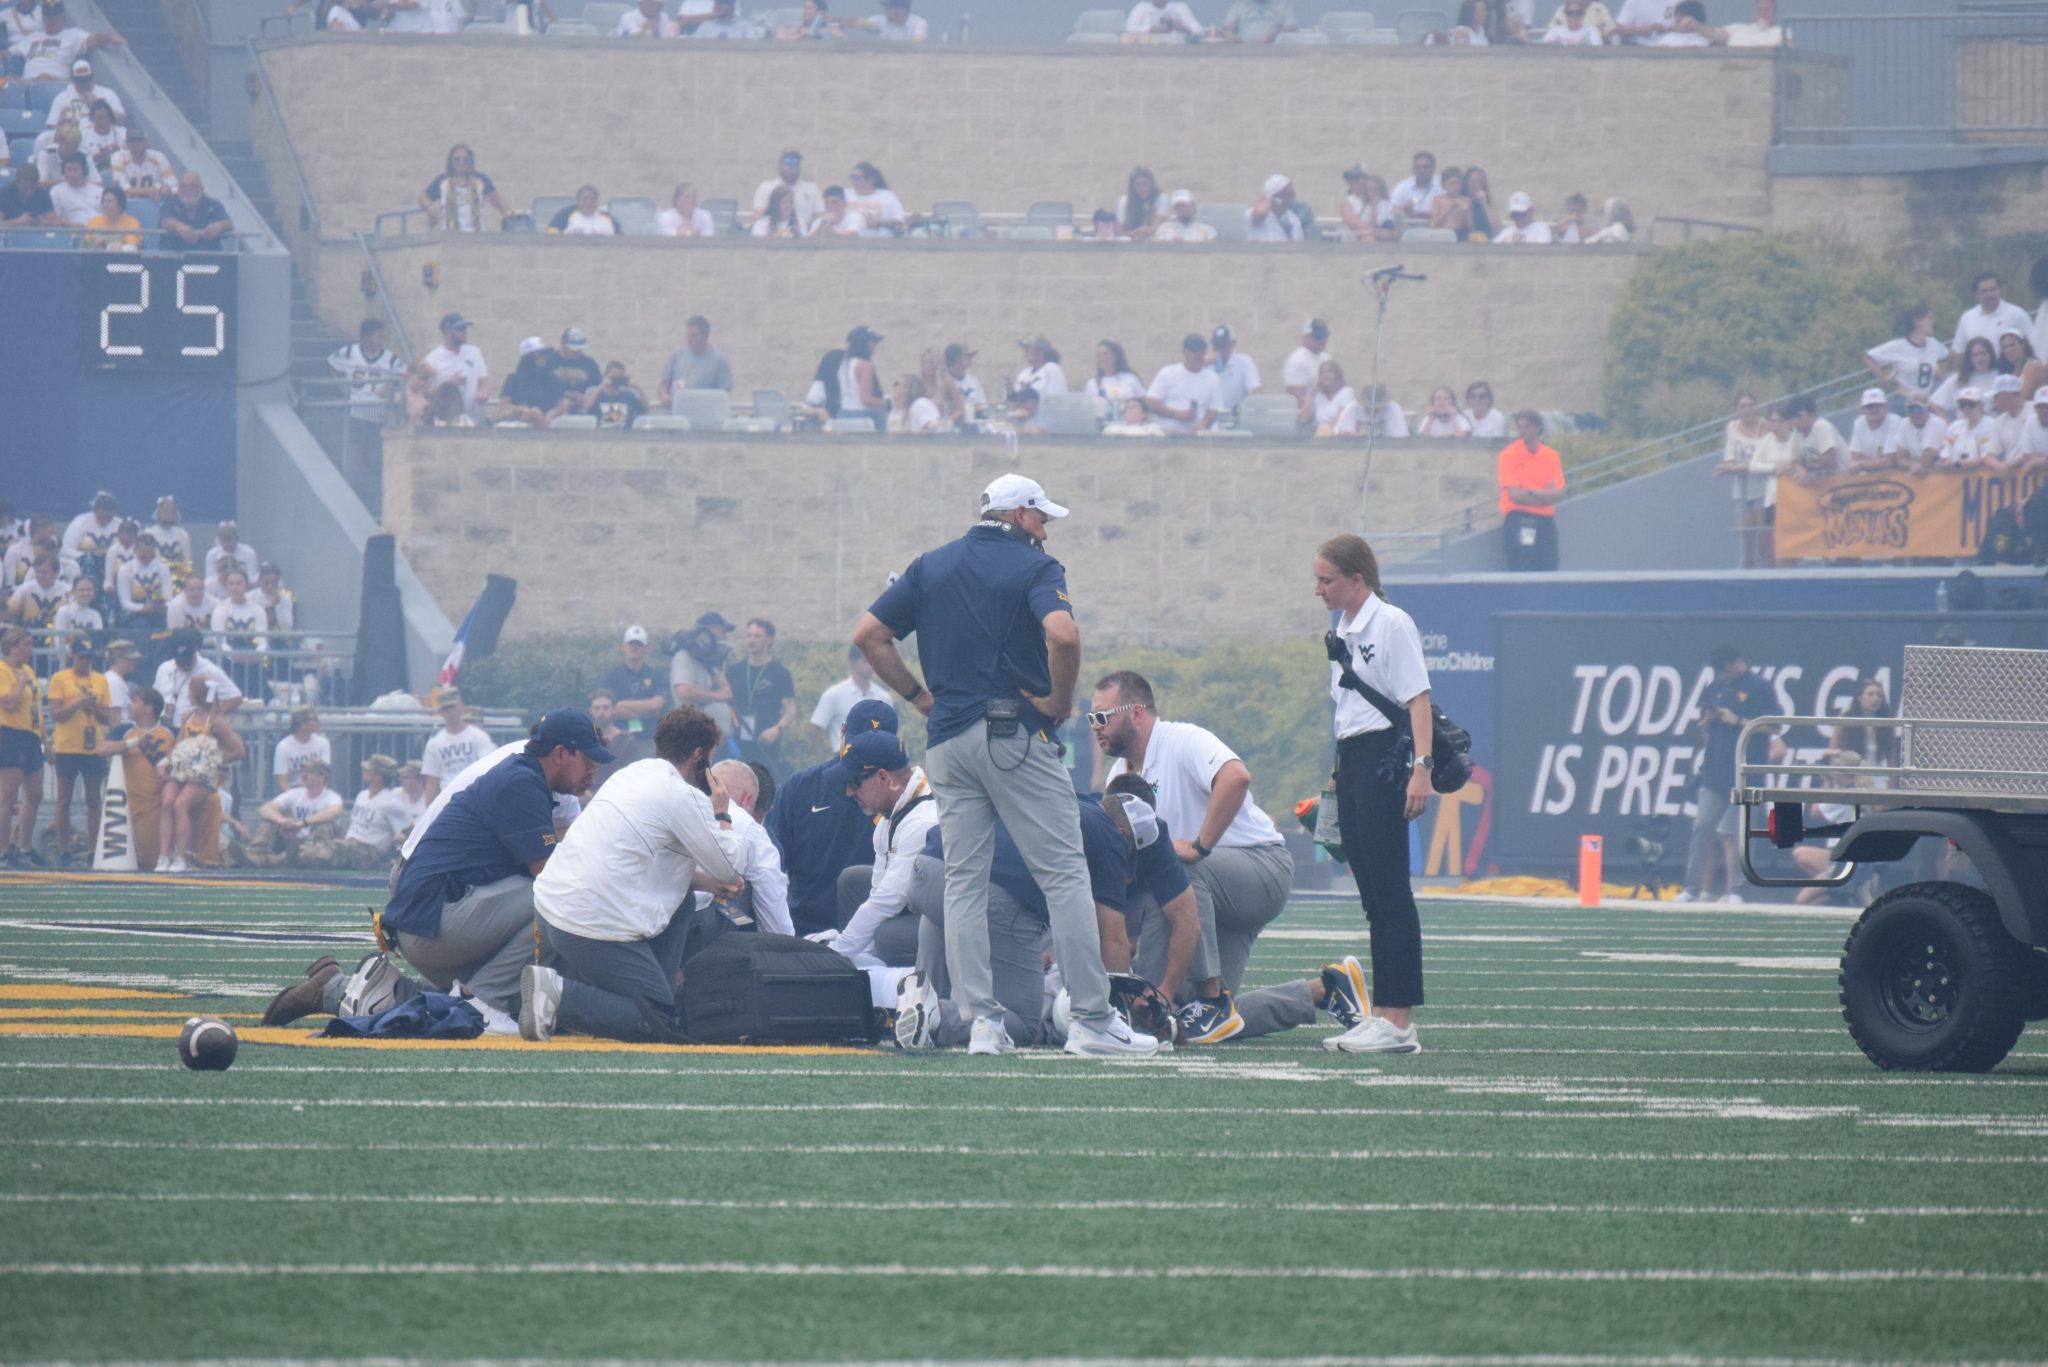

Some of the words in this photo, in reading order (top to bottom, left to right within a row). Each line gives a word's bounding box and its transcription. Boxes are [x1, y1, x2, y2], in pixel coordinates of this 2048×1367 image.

[100, 263, 225, 356] 25
[438, 742, 473, 760] WVU
[1529, 744, 1583, 816] IS
[103, 787, 128, 860] WVU
